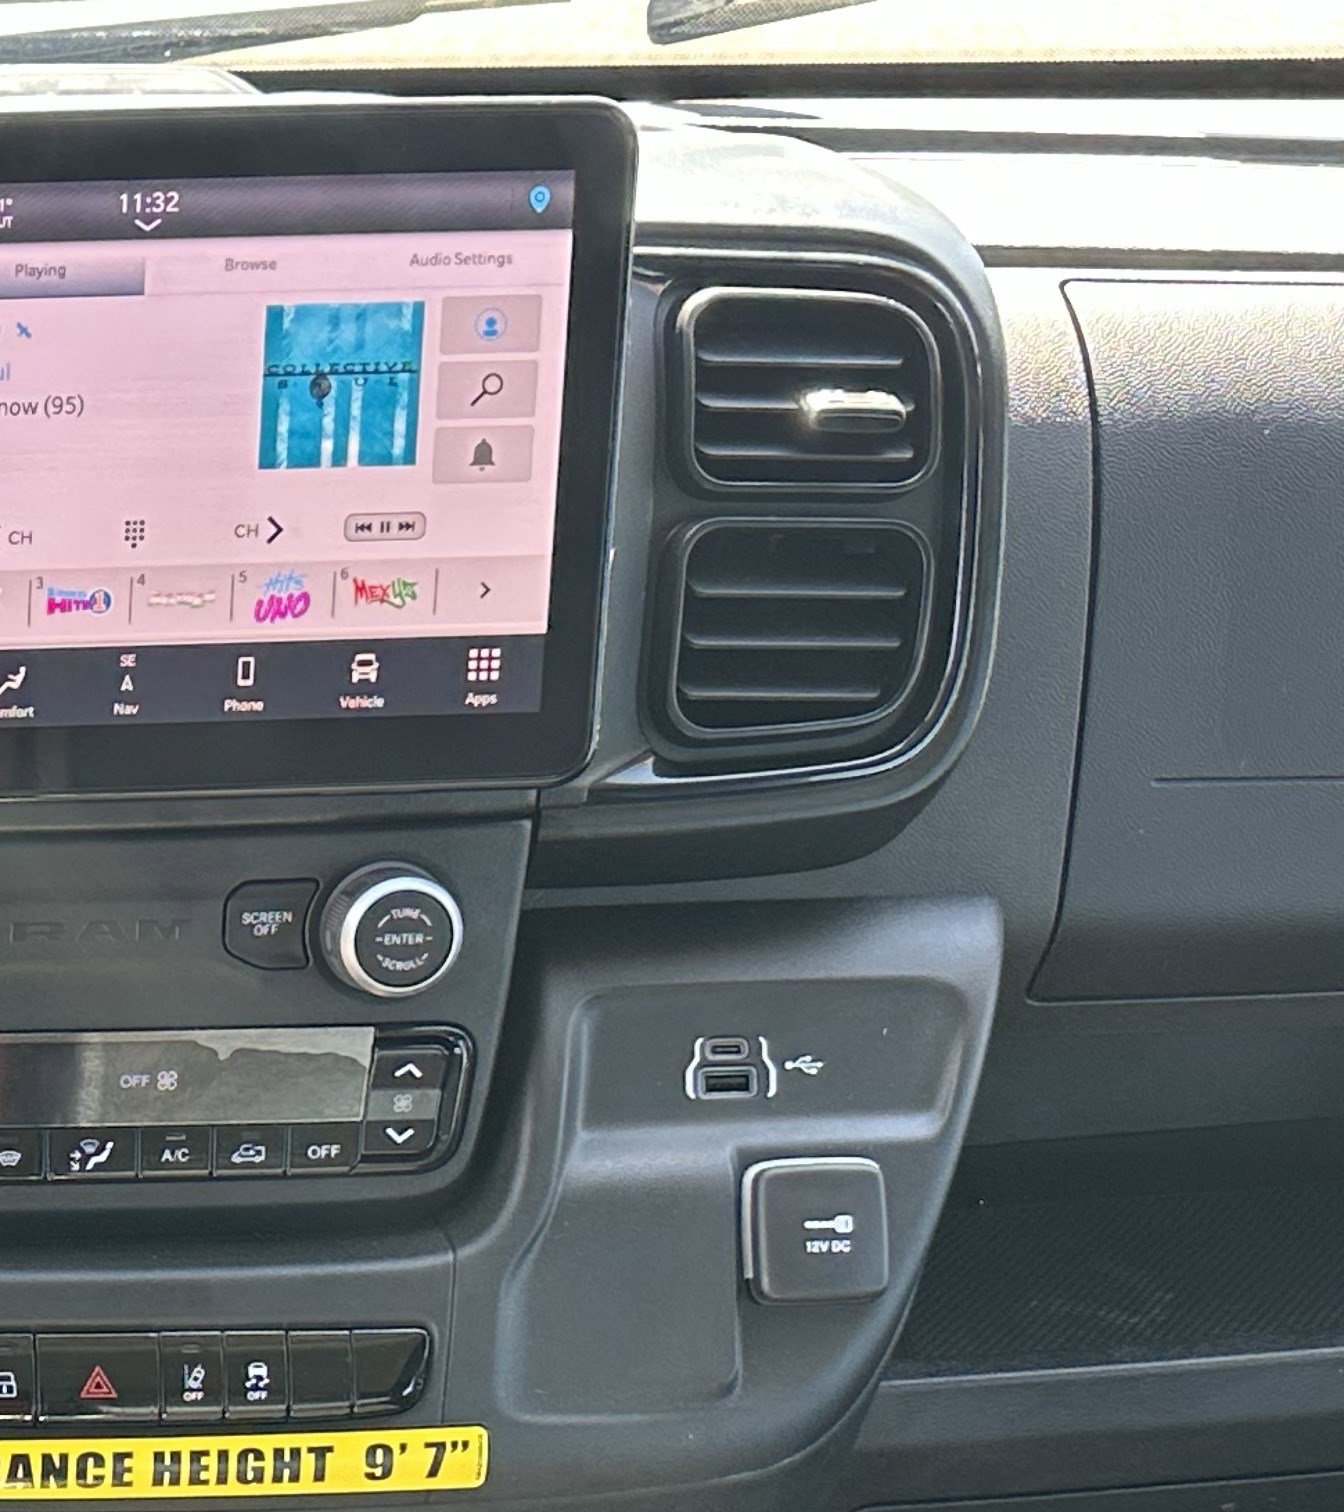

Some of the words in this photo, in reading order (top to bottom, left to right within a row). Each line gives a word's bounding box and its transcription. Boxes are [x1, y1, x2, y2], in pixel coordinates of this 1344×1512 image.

[119, 191, 180, 214] 11:32
[224, 258, 278, 272] Browse
[409, 252, 451, 268] Audio
[453, 251, 514, 269] Settings
[14, 263, 67, 280] Playing
[43, 394, 85, 419] (95)
[7, 530, 33, 547] CH
[233, 523, 259, 540] CH
[136, 573, 145, 586] 4
[238, 570, 248, 583] 5
[340, 567, 350, 580] 6
[35, 577, 44, 590] 3
[119, 653, 137, 668] SE
[223, 699, 265, 713] Phone
[339, 694, 385, 710] Vehicle
[464, 692, 498, 707] Apps
[113, 702, 140, 716] Nav
[241, 910, 293, 925] SCREEN
[9, 916, 192, 945] RAM
[253, 922, 279, 937] OFF
[383, 932, 425, 946] ENTER
[381, 956, 425, 971] SCROLL
[119, 1073, 151, 1089] OFF
[160, 1147, 190, 1163] A/C
[307, 1143, 342, 1160] OFF
[805, 1239, 830, 1253] 12V
[830, 1239, 852, 1253] DC
[182, 1390, 205, 1402] OFF
[246, 1390, 269, 1401] OFF
[151, 1445, 335, 1486] HEIGHT
